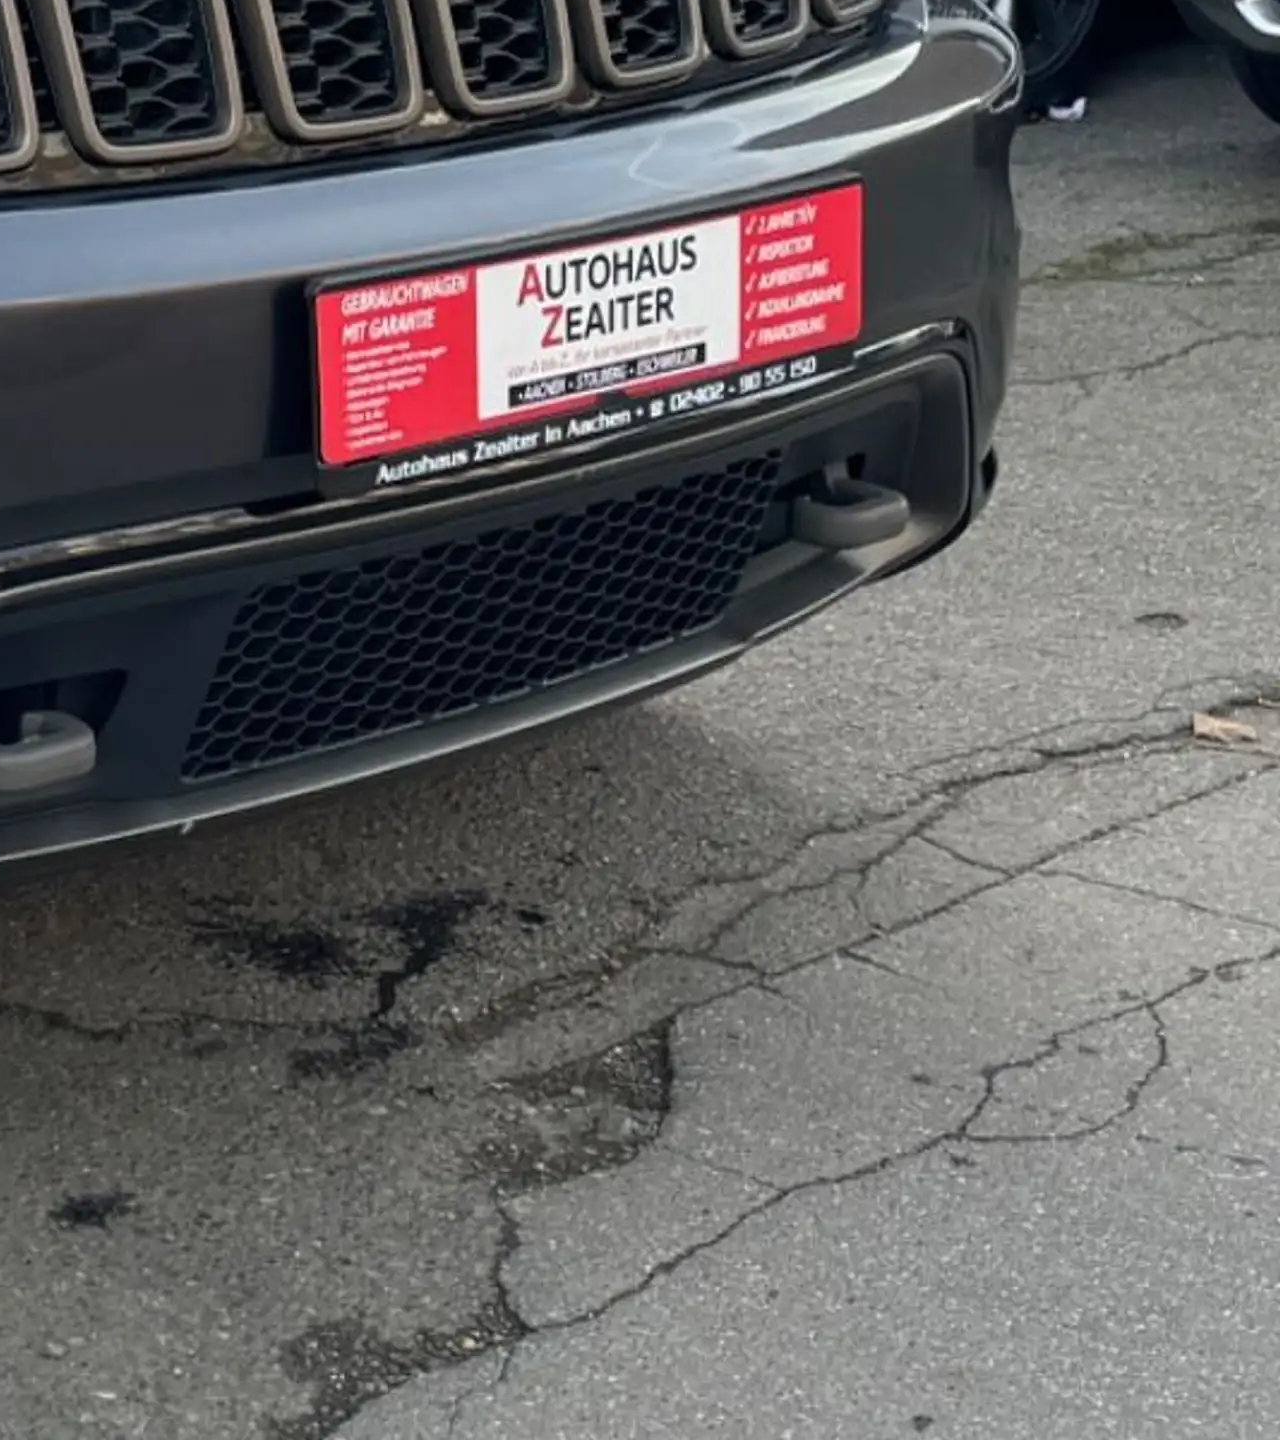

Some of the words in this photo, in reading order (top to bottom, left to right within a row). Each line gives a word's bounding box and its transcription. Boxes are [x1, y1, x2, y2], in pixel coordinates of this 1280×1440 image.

[517, 235, 698, 308] AUTOHAUS
[541, 286, 675, 349] ZEAITER
[374, 446, 469, 486] Autohaus
[472, 430, 540, 461] Zeaiter
[566, 408, 632, 439] Aachen
[763, 364, 787, 387] 55
